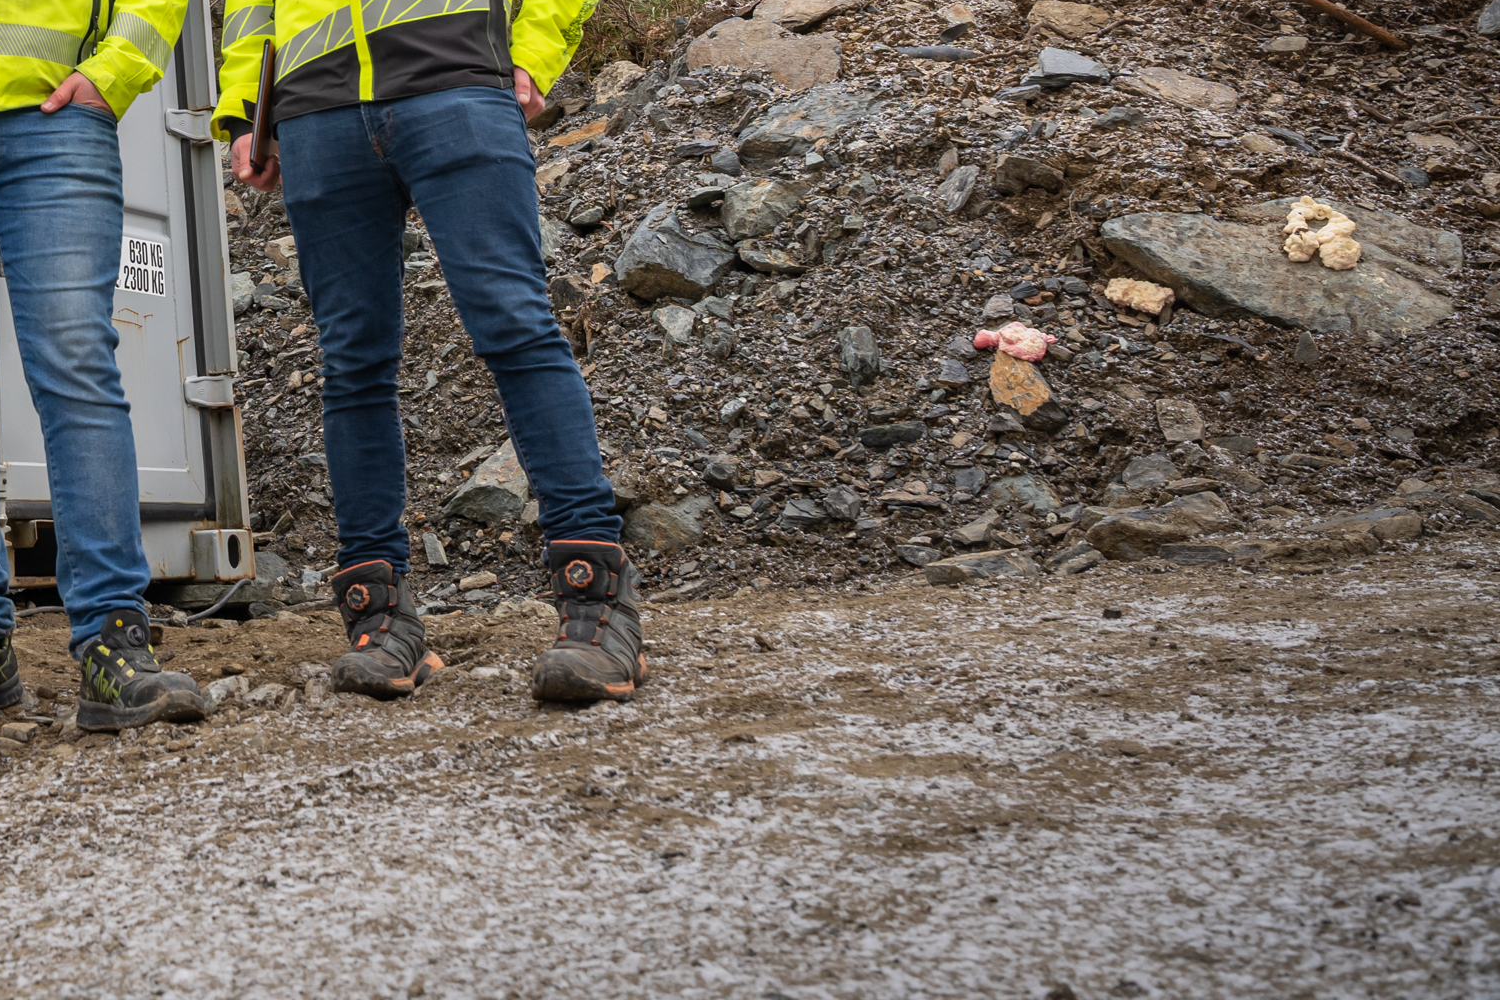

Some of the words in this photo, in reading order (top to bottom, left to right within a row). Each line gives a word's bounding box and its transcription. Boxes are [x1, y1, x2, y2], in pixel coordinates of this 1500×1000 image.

[129, 239, 148, 265] 630
[150, 243, 163, 268] KG
[123, 265, 149, 292] 2300
[152, 269, 164, 295] KG
